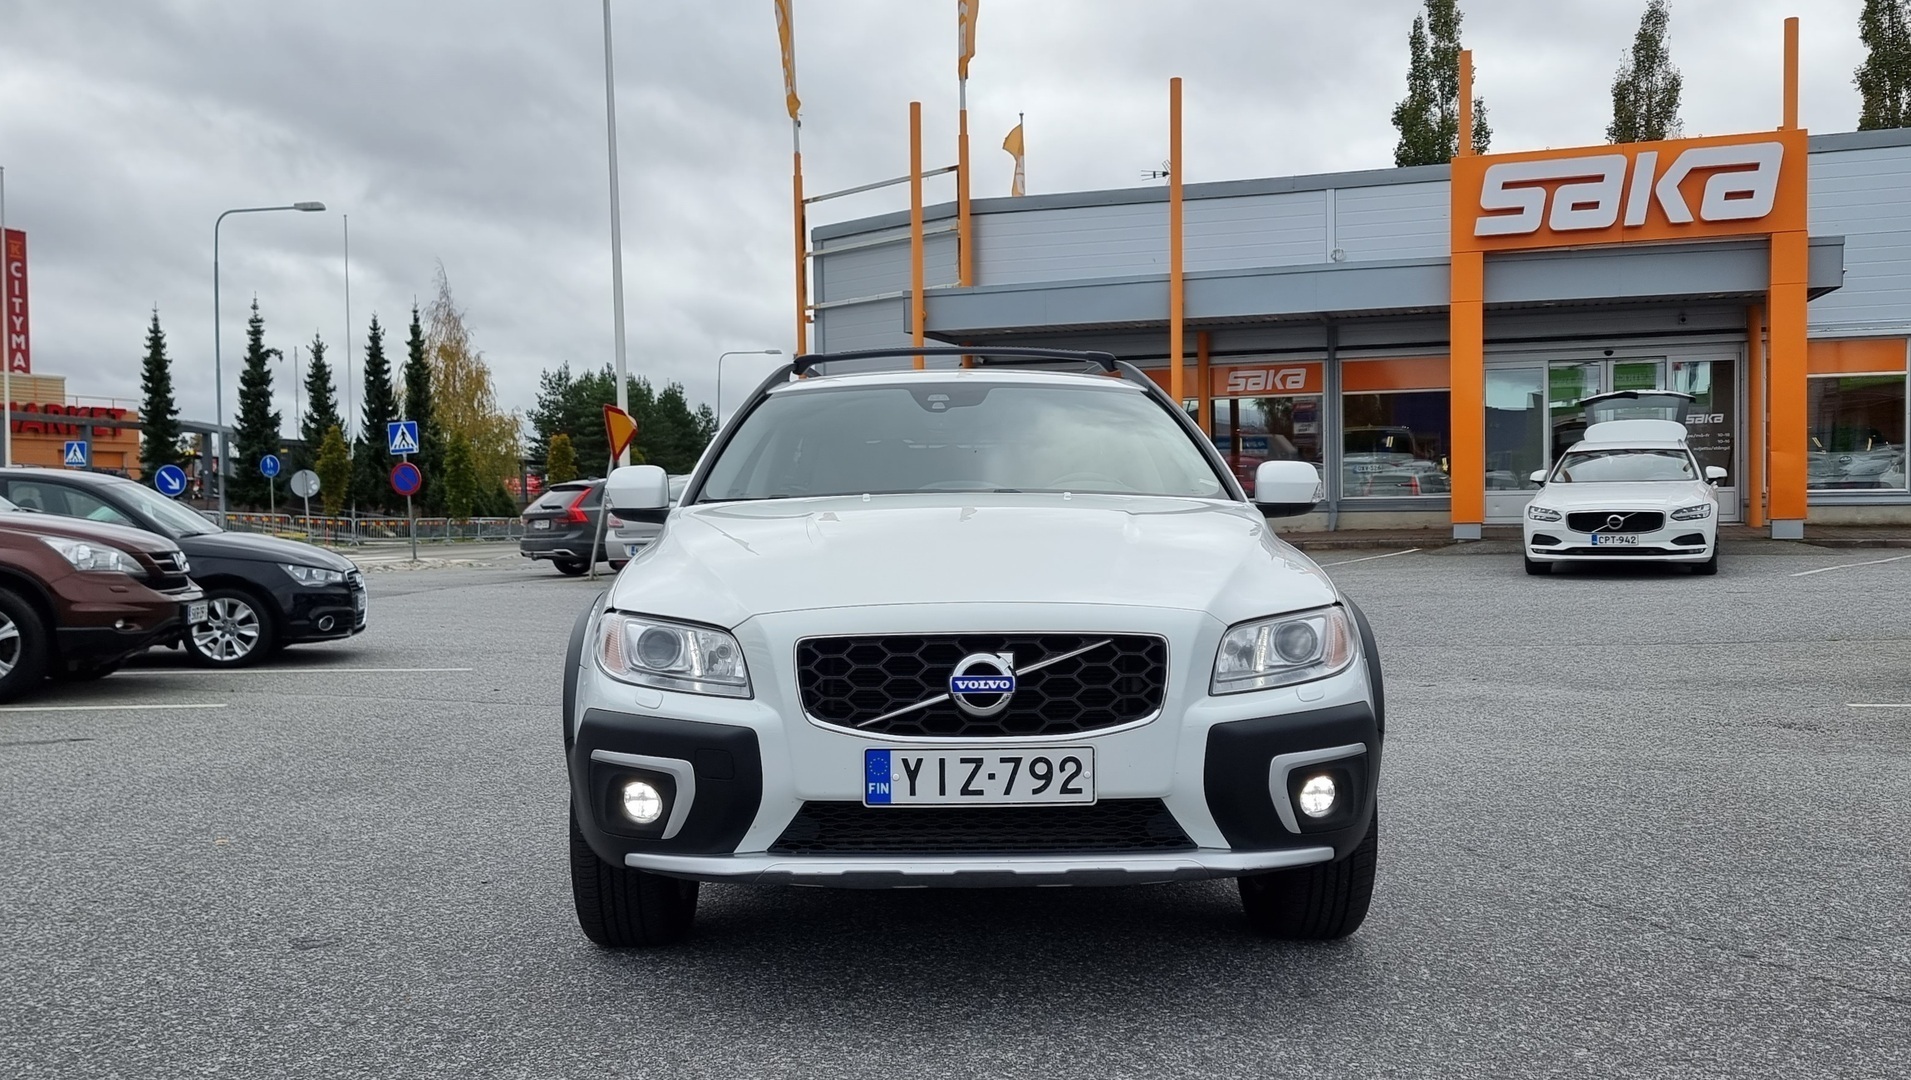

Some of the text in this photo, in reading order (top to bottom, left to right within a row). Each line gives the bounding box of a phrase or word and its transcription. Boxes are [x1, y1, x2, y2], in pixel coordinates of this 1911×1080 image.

[10, 262, 26, 374] CITYMA
[1598, 536, 1637, 544] CPT-942
[955, 679, 1011, 690] VOLVO
[901, 756, 1083, 796] YIZ-792
[868, 782, 890, 794] FIN
